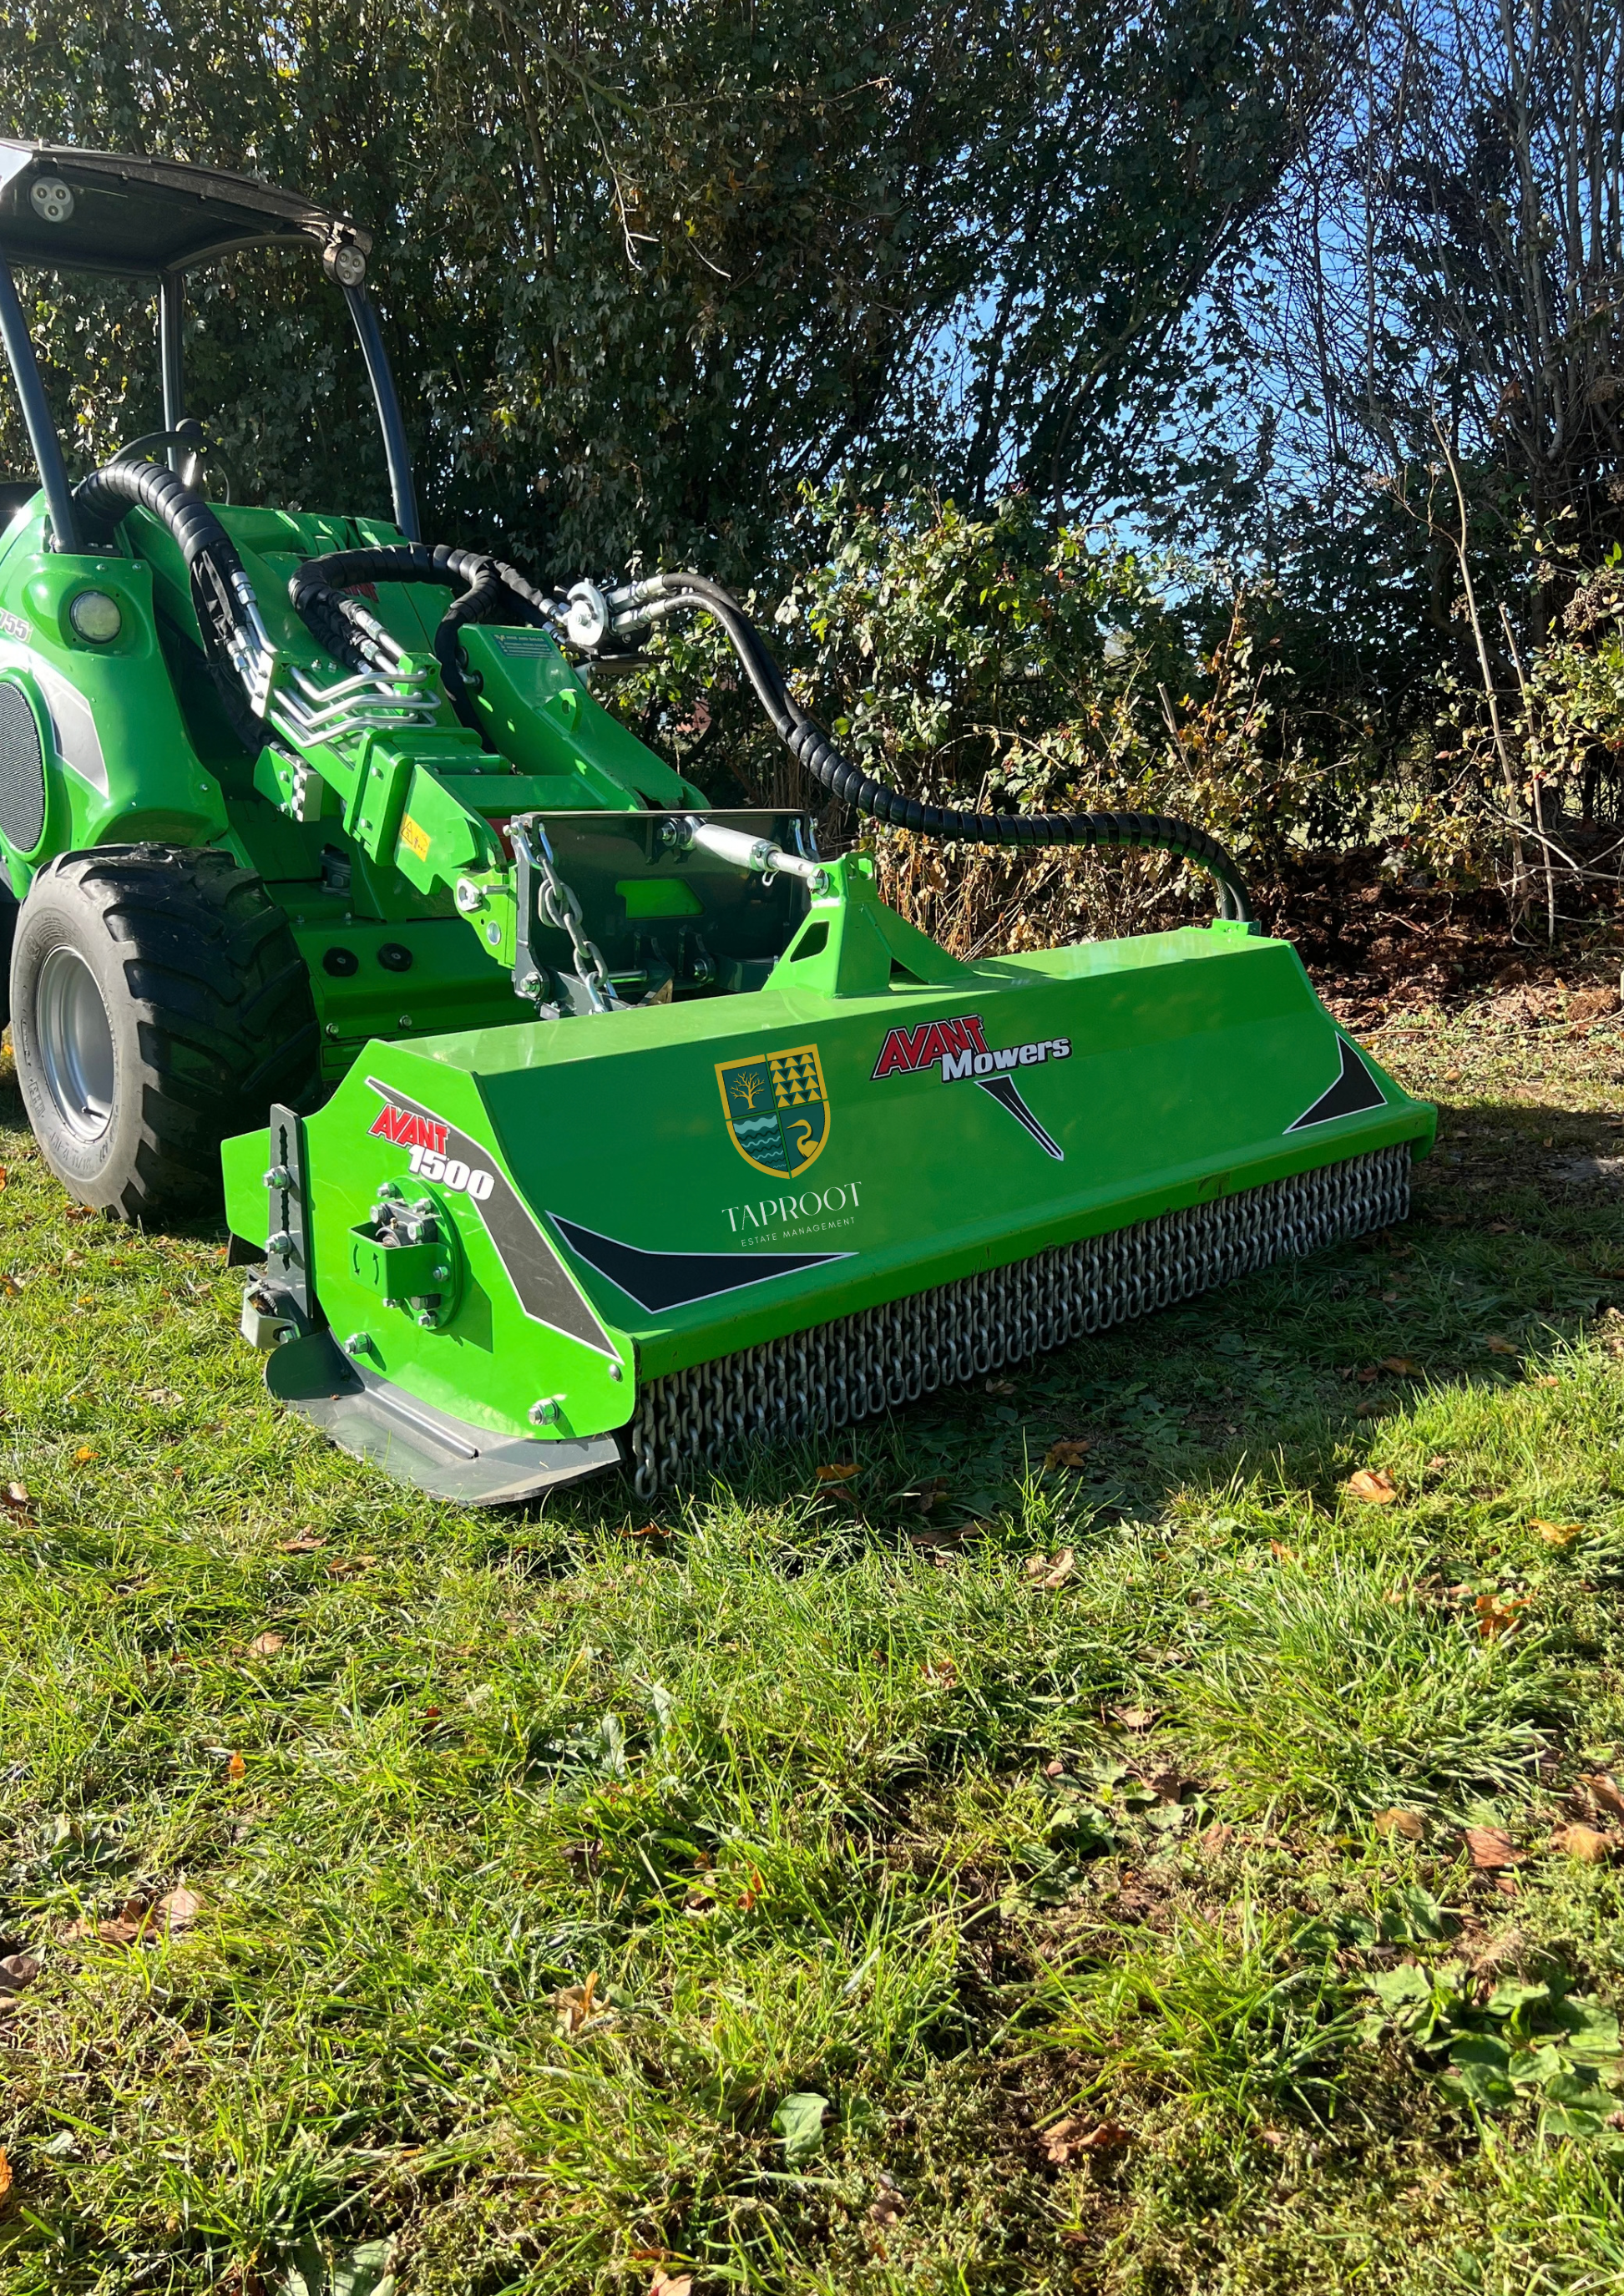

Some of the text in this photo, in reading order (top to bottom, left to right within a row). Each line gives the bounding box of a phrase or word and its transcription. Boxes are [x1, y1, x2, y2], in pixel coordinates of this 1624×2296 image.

[871, 1014, 990, 1080] AVANT
[942, 1037, 1072, 1083] Mowers
[367, 1103, 450, 1156] AVANT
[408, 1144, 495, 1201] 1500
[721, 1181, 862, 1232] TAPROOT
[741, 1216, 855, 1247] ESTATE MANAGEMENT
